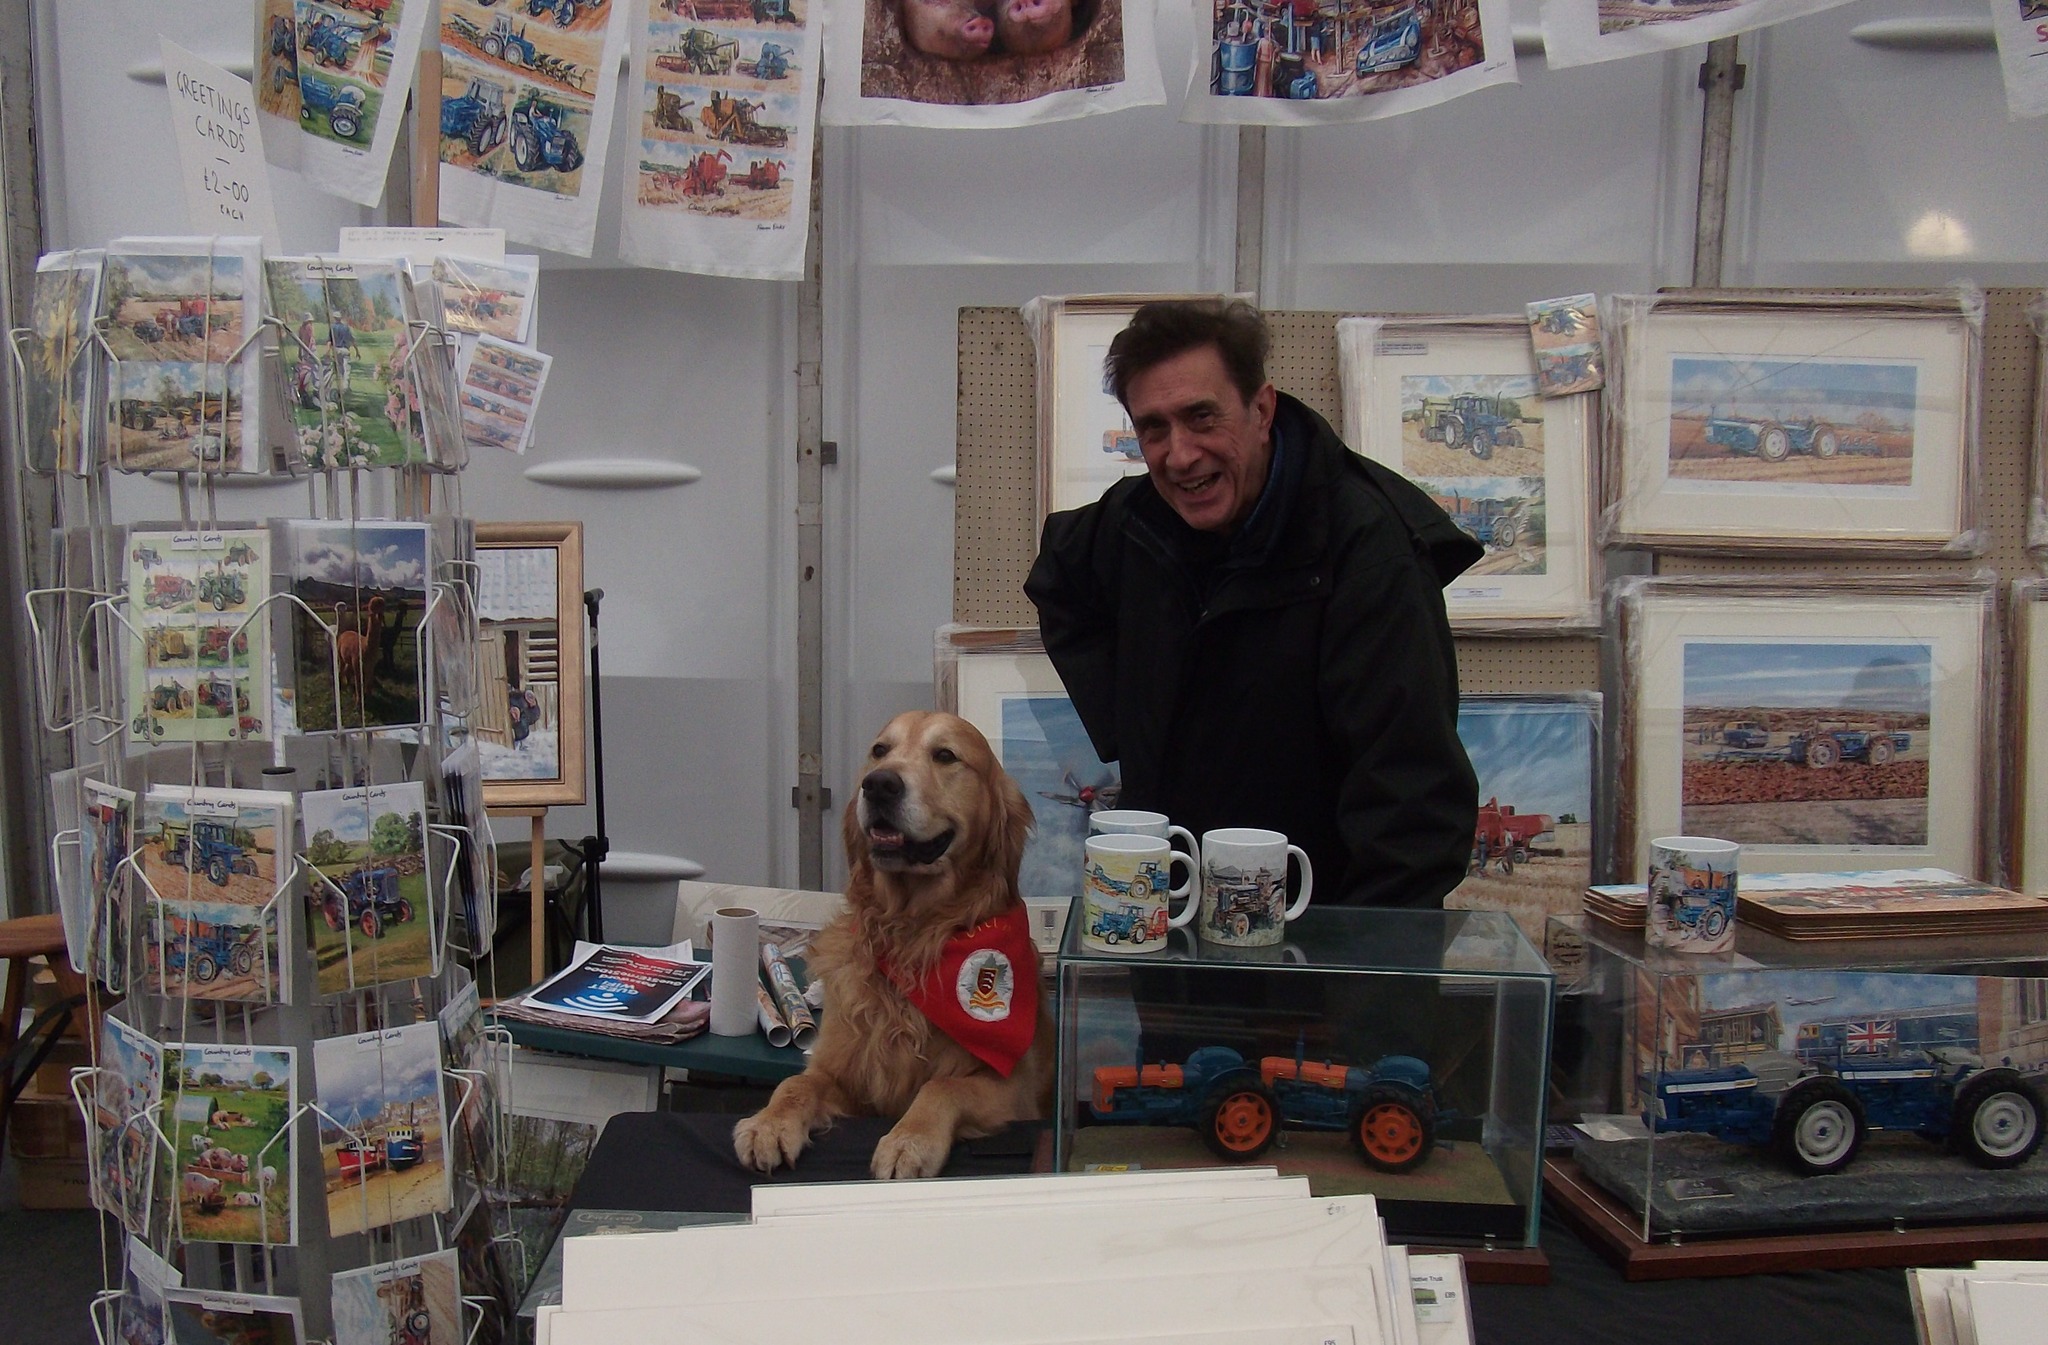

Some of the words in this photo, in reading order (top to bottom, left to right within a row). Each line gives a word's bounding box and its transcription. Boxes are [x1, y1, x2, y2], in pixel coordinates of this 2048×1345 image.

[176, 70, 251, 131] GREETINGS
[195, 115, 246, 153] CARDS
[204, 167, 250, 203] £2-00
[335, 264, 354, 273] Cards
[172, 535, 199, 543] Countr
[342, 791, 367, 801] Countr
[186, 798, 215, 810] Cuntry
[216, 799, 237, 810] Cards
[587, 982, 640, 996] GUEST
[204, 1047, 231, 1058] Country
[232, 1047, 252, 1057] Cards
